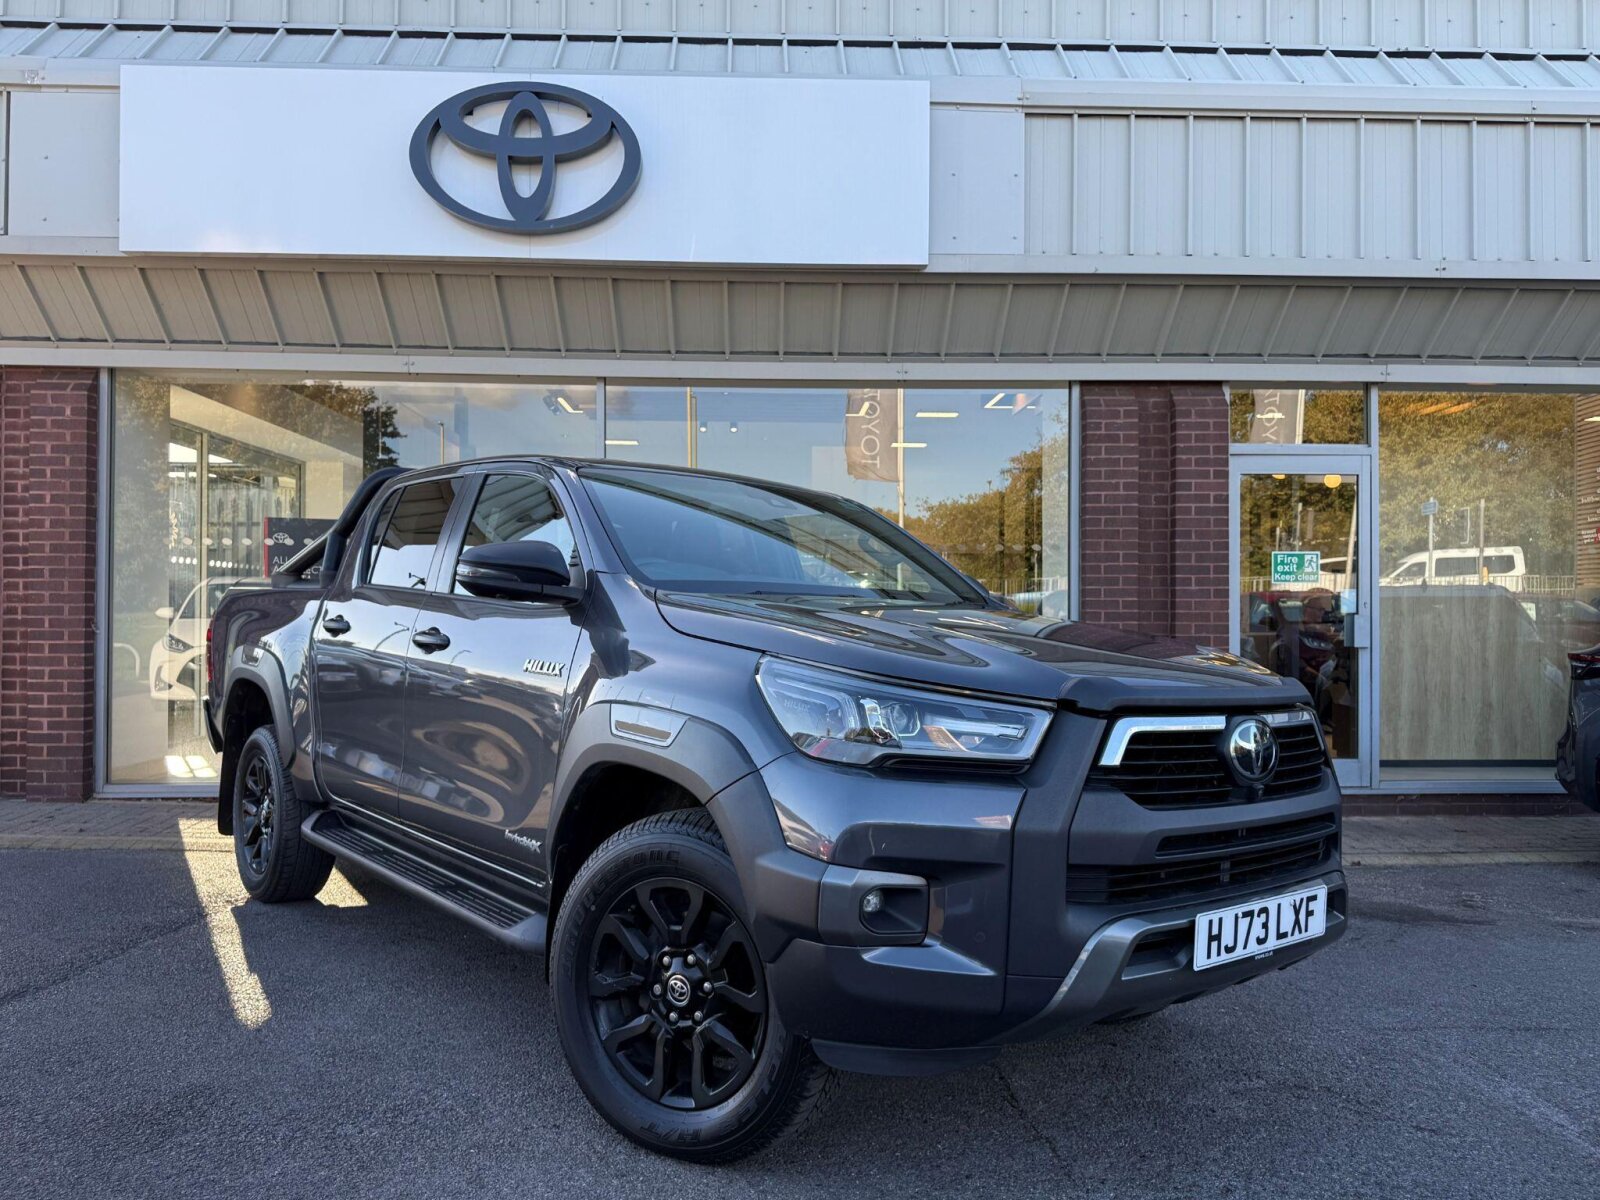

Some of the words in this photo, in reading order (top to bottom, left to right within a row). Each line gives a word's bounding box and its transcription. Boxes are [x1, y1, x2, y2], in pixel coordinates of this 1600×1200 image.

[1277, 554, 1298, 564] Fire
[1277, 563, 1297, 572] exit
[1274, 573, 1296, 582] Keep
[1297, 573, 1318, 581] clear
[523, 658, 566, 678] HILUX
[1206, 906, 1270, 960] HJ73
[1276, 894, 1318, 940] LXF
